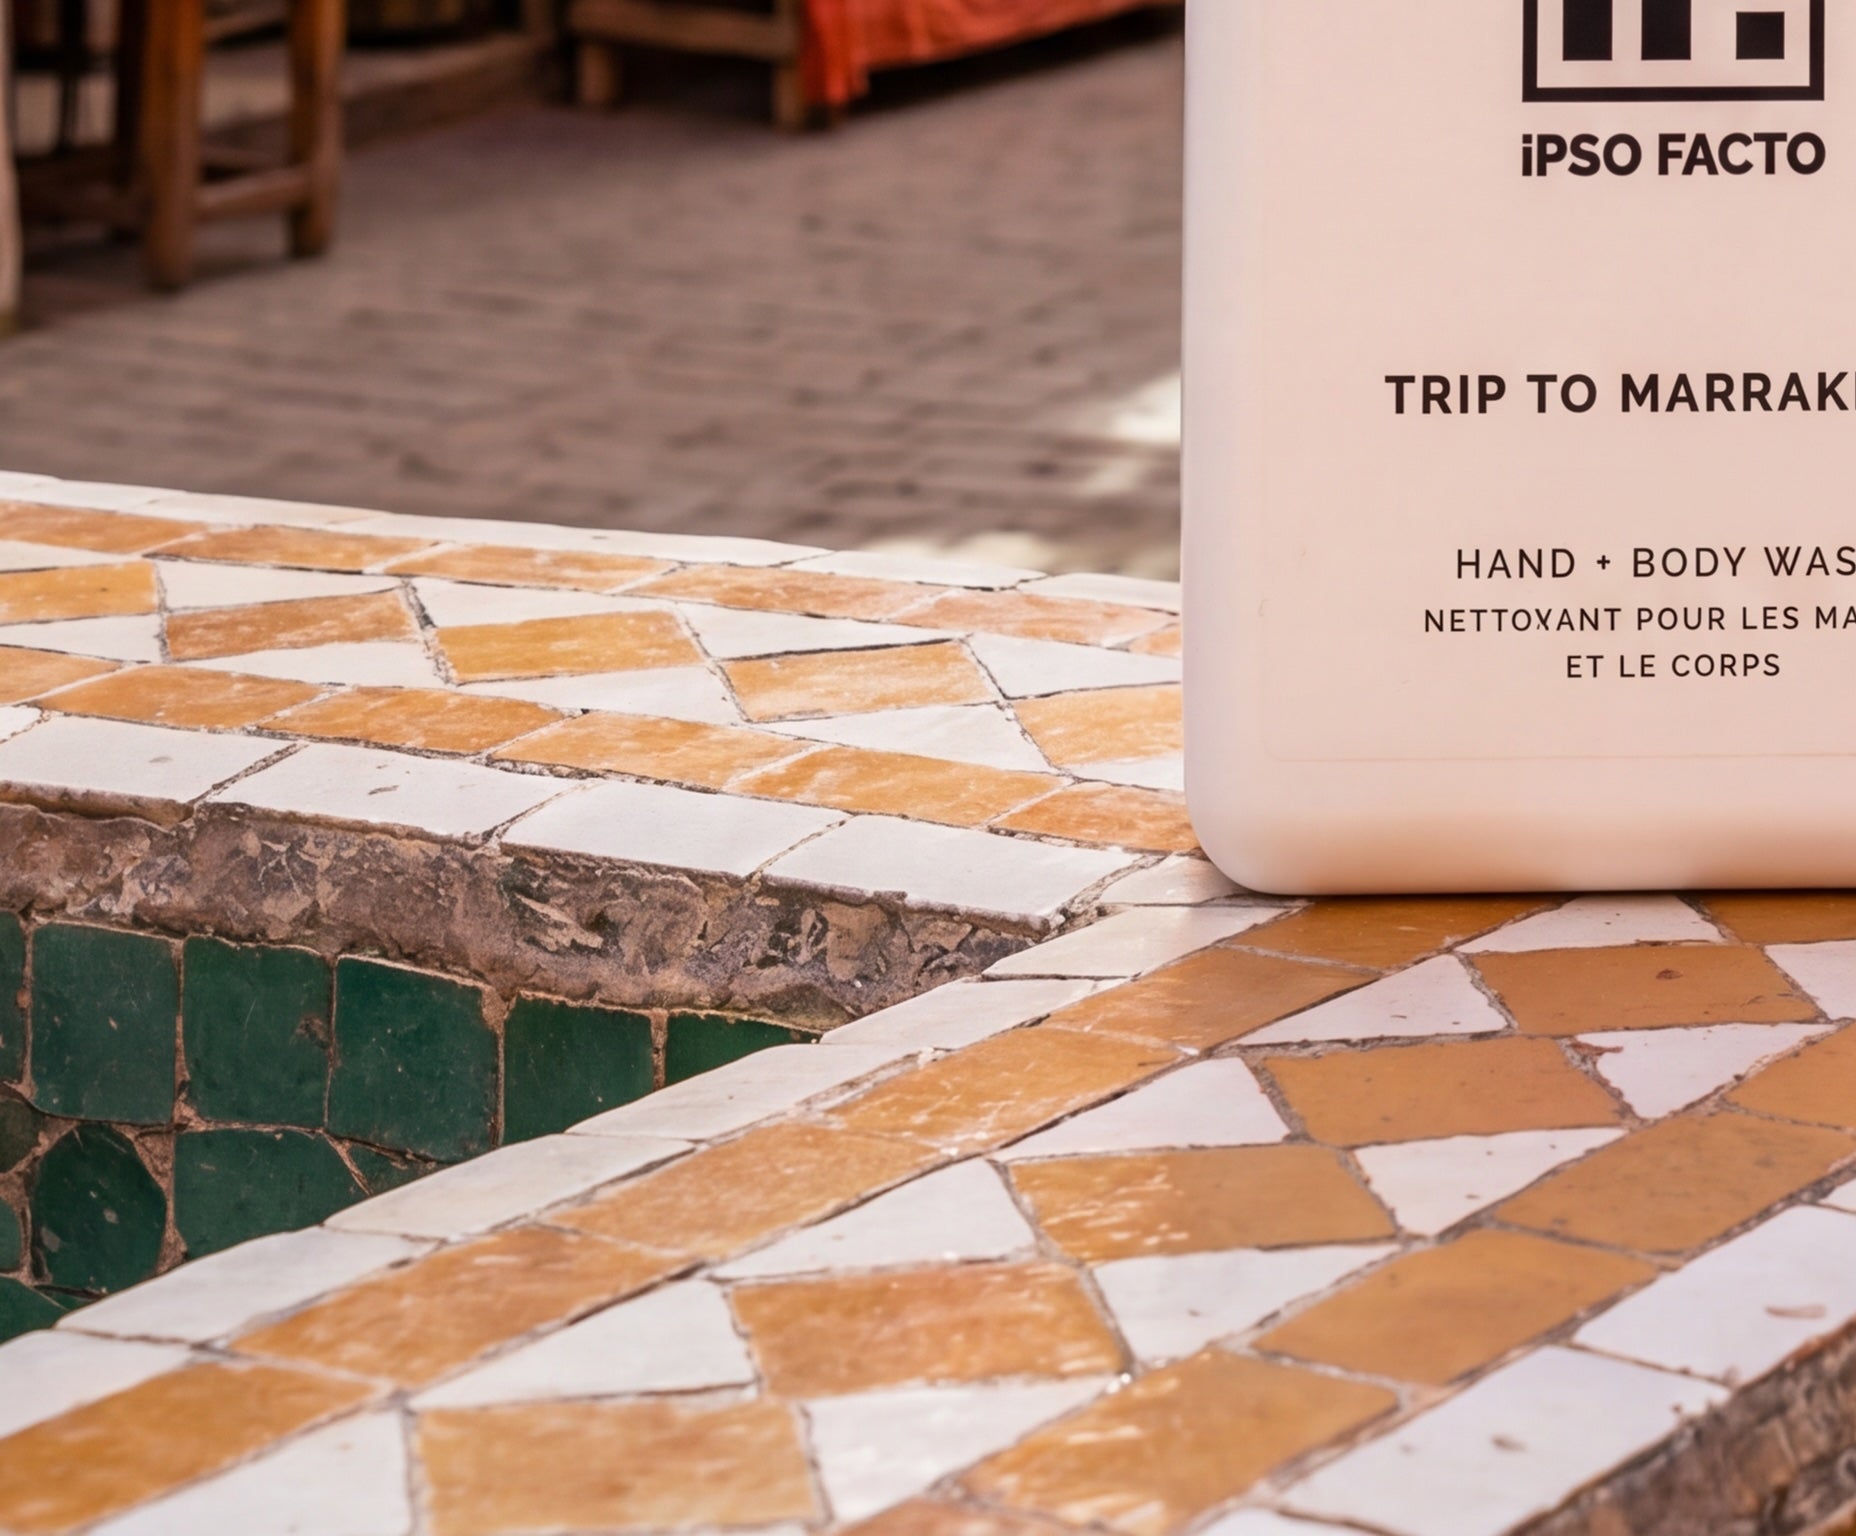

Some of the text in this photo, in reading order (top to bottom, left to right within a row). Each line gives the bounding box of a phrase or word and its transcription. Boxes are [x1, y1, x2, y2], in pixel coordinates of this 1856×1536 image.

[1521, 131, 1826, 177] iPSO FACTO
[1384, 374, 1506, 415] TRIP
[1526, 373, 1597, 414] TO
[1457, 548, 1575, 580] HAND
[1633, 546, 1747, 578] BODY
[1637, 606, 1725, 632] POUR
[1742, 606, 1799, 631] LES
[1567, 653, 1780, 679] ET LE CORPS
